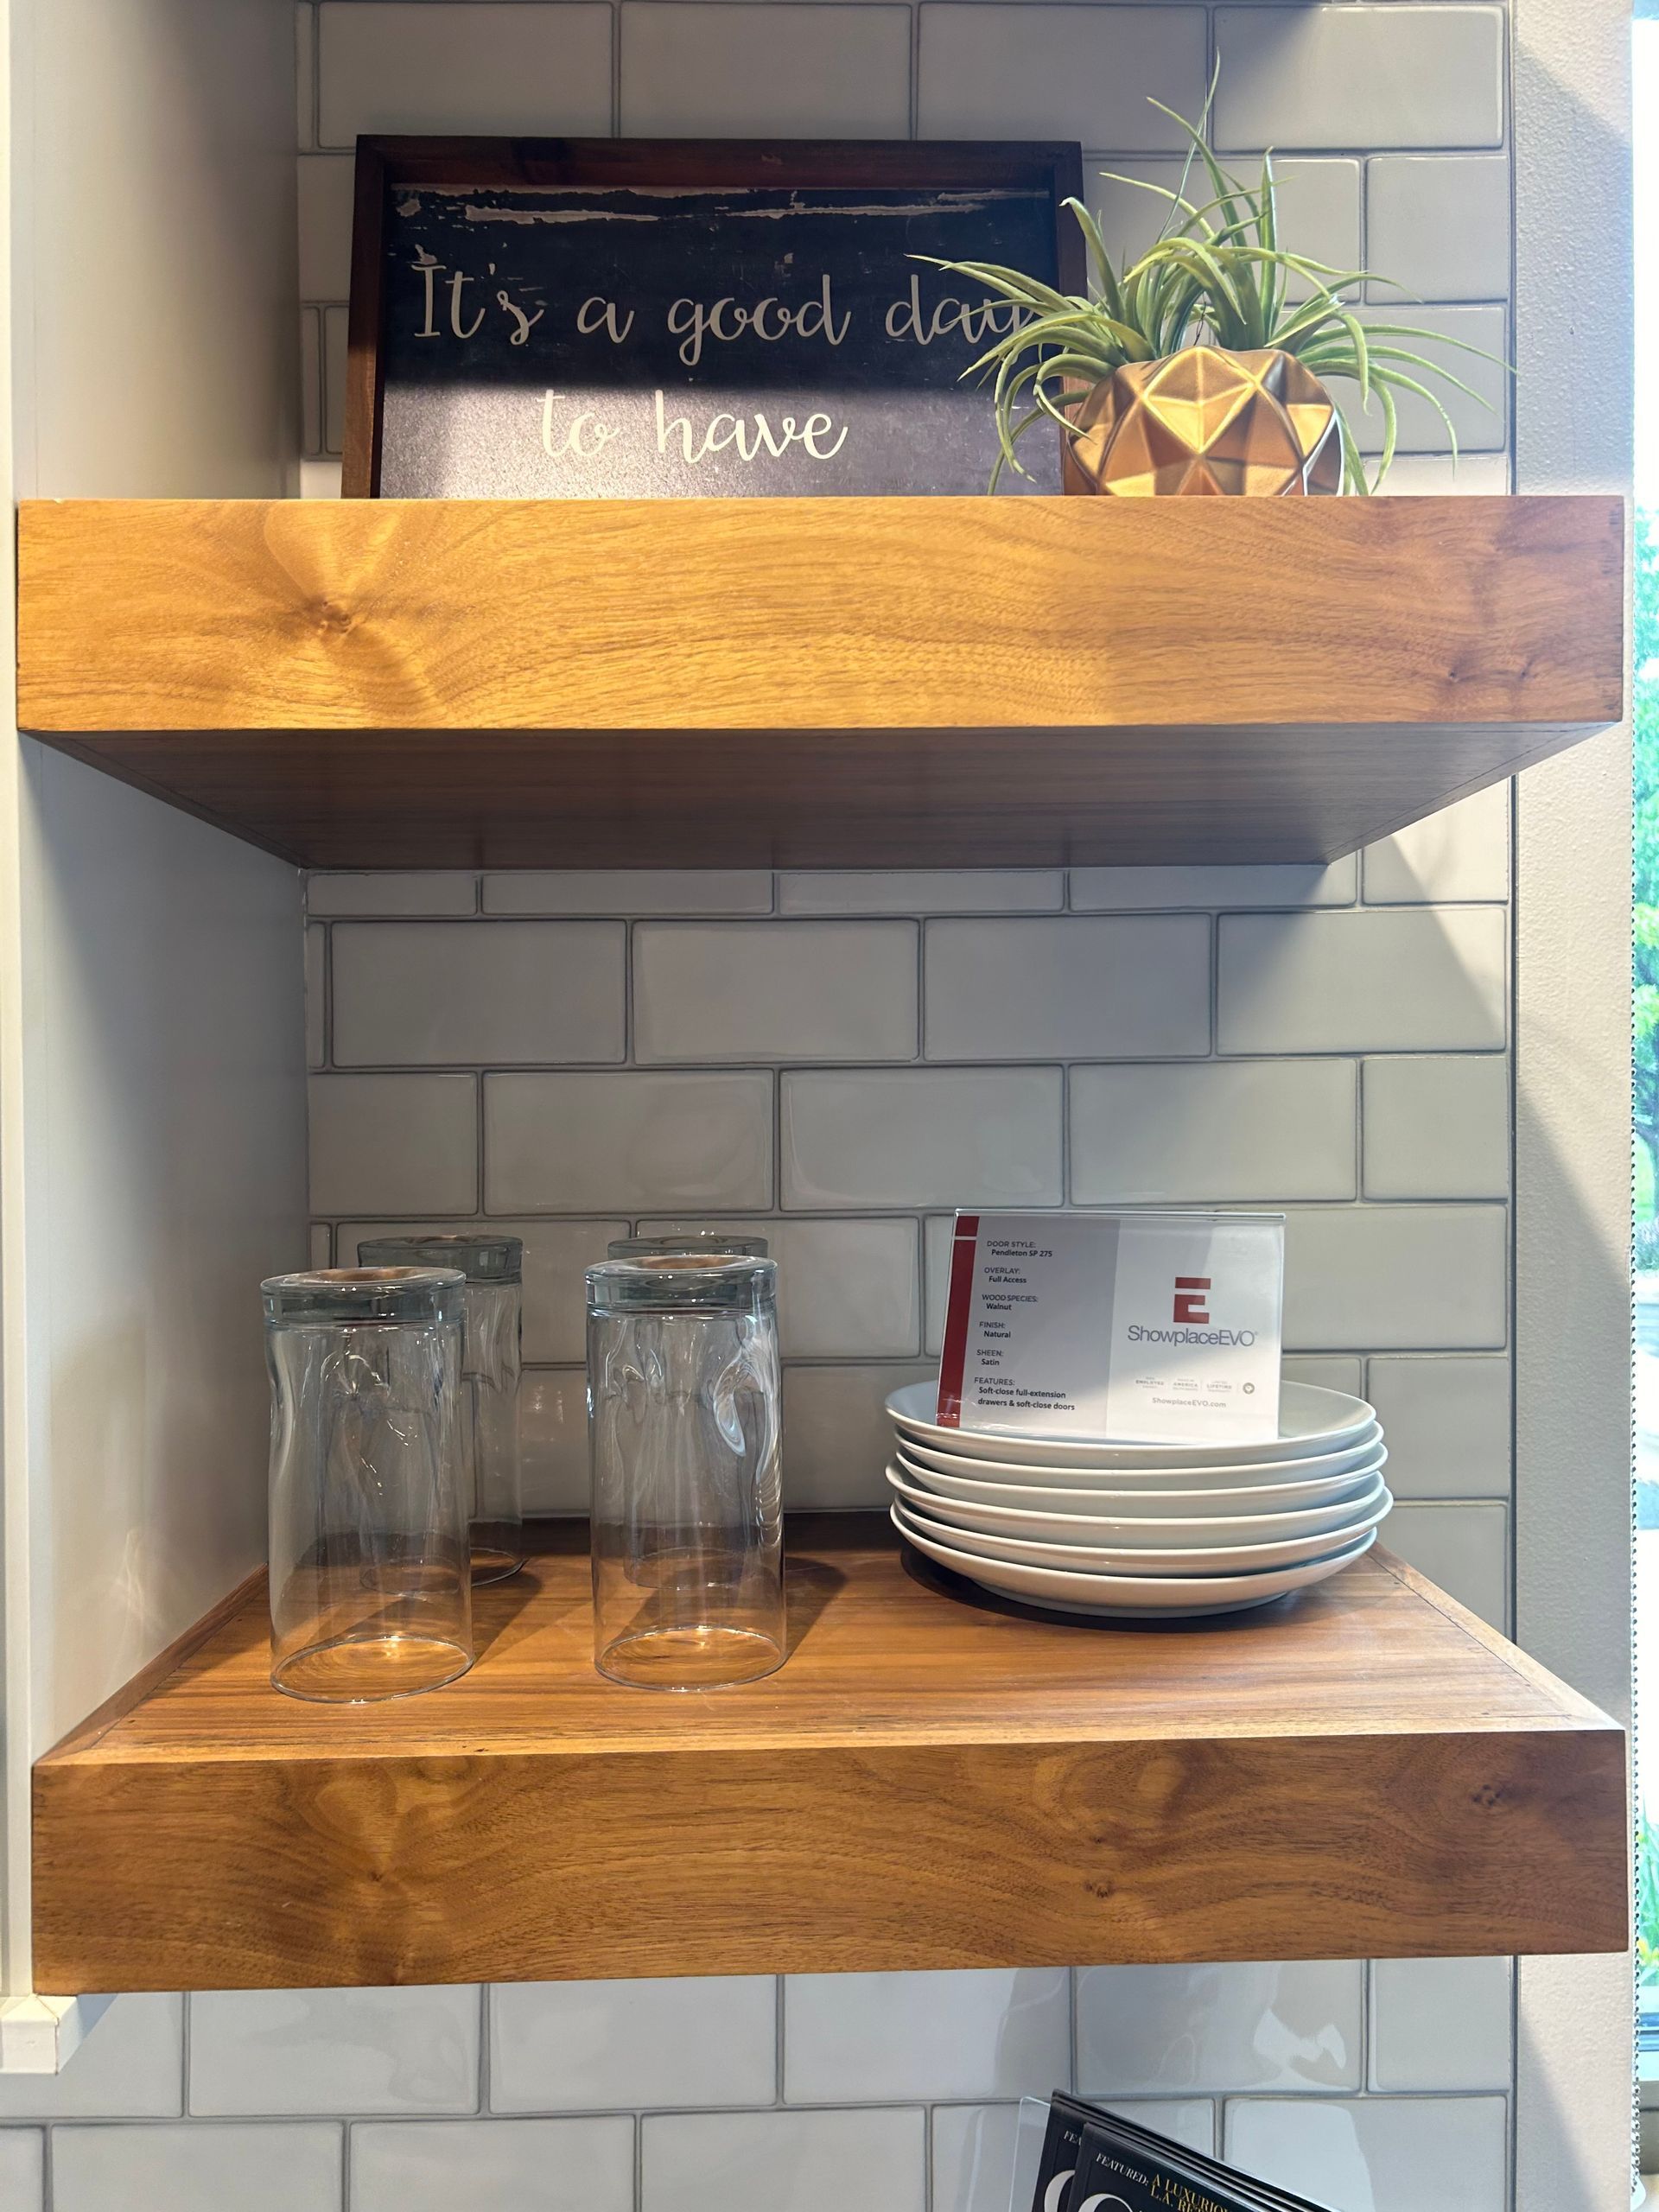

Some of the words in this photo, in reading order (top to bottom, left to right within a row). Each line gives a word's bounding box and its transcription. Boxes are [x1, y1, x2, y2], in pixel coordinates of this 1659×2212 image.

[411, 263, 544, 346] It's
[576, 296, 634, 344] a
[666, 274, 851, 366] good
[536, 389, 618, 459] to
[655, 389, 849, 464] have
[974, 1376, 1015, 1386] FEATURES:
[978, 1387, 1014, 1395] Soft-close
[1015, 1389, 1066, 1398] full-extension
[1016, 1400, 1052, 1409] soft-close
[1152, 1397, 1227, 1408] ShowplaceEVO.com
[1096, 2152, 1149, 2187] FEATURED:
[1152, 2173, 1161, 2187] A
[1150, 2184, 1173, 2208] L.A.
